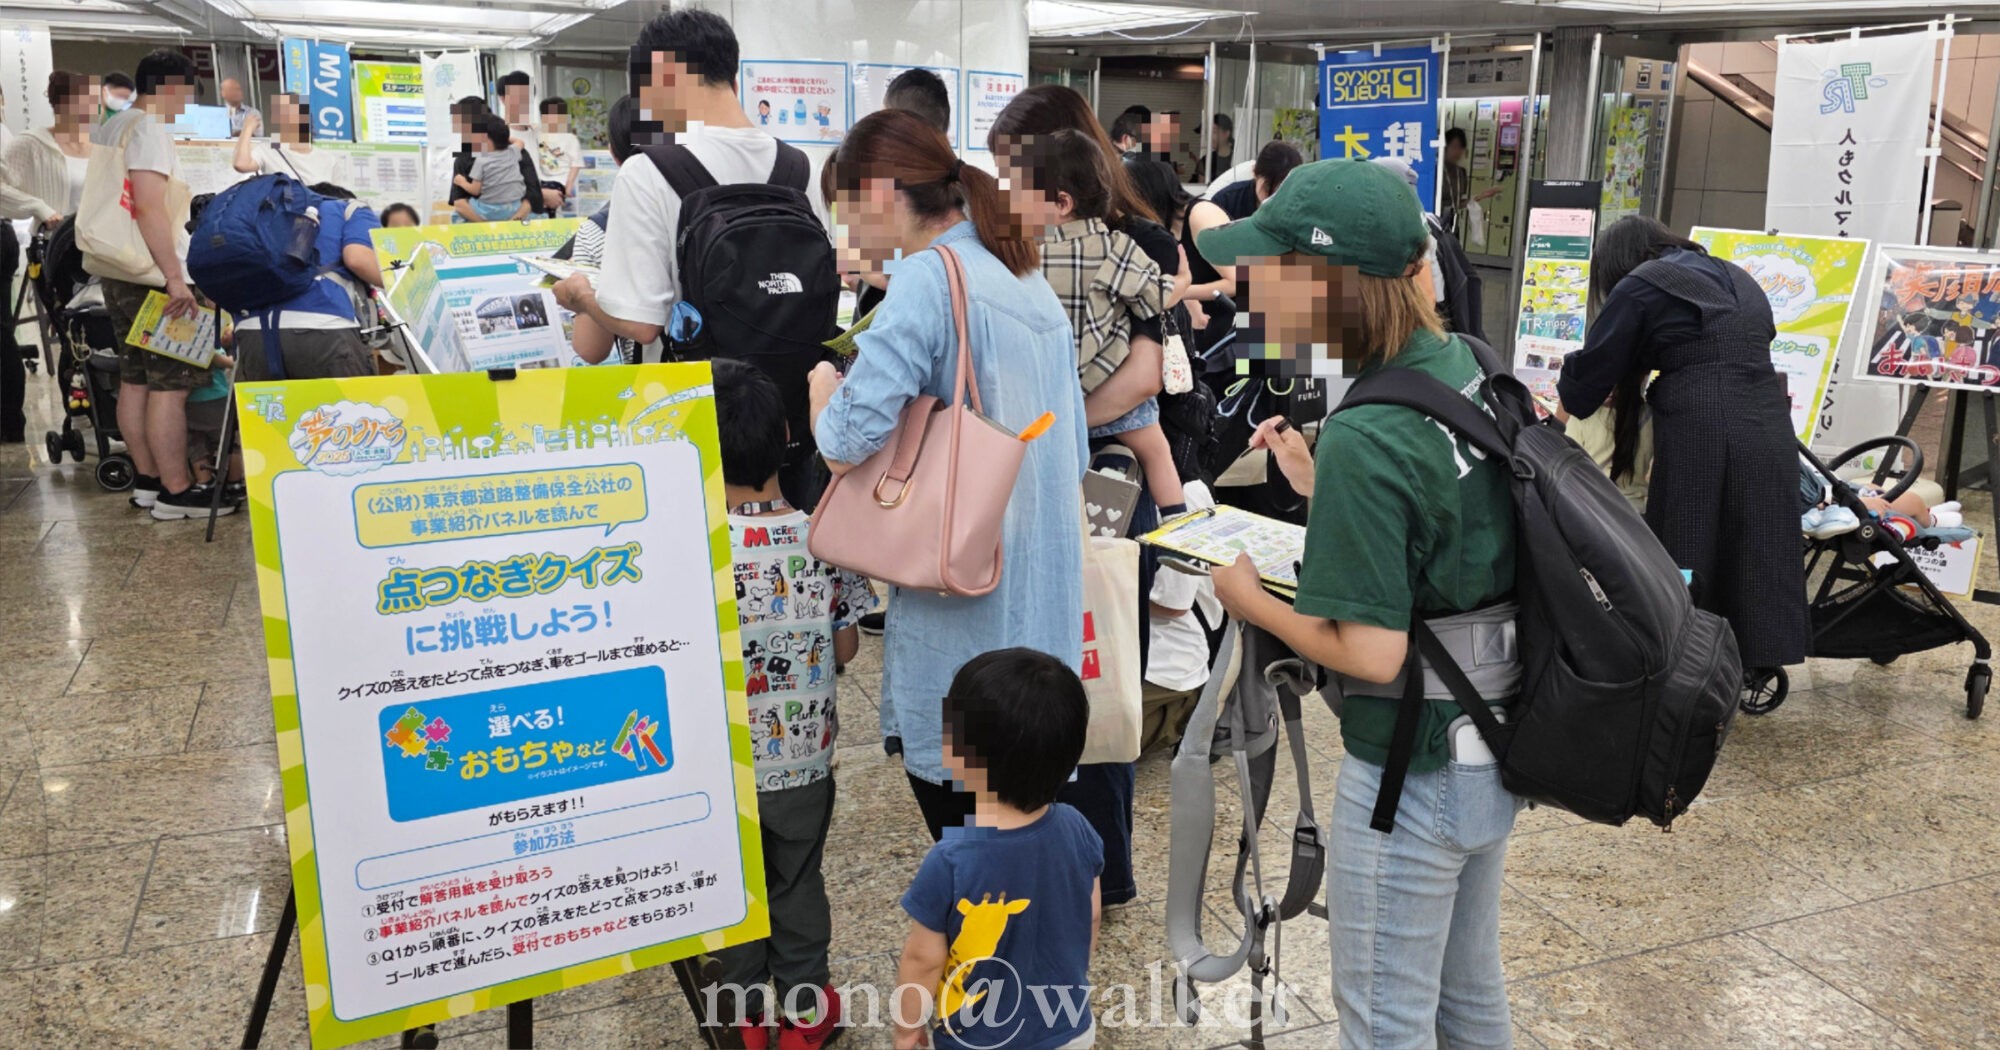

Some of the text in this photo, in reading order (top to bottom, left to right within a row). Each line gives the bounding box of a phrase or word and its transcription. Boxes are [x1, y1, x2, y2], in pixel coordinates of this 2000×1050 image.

[314, 52, 344, 141] My Ci
[758, 280, 786, 288] NORTH
[367, 477, 633, 515] (公財)東京都道路整備保全公社の
[410, 504, 599, 536] 事業紹介パネルを読んで
[378, 542, 642, 615] 点つなぎクイズ
[406, 601, 613, 655] に挑戦しよう！
[488, 705, 565, 739] 選べる！
[513, 829, 576, 855] 参加方法
